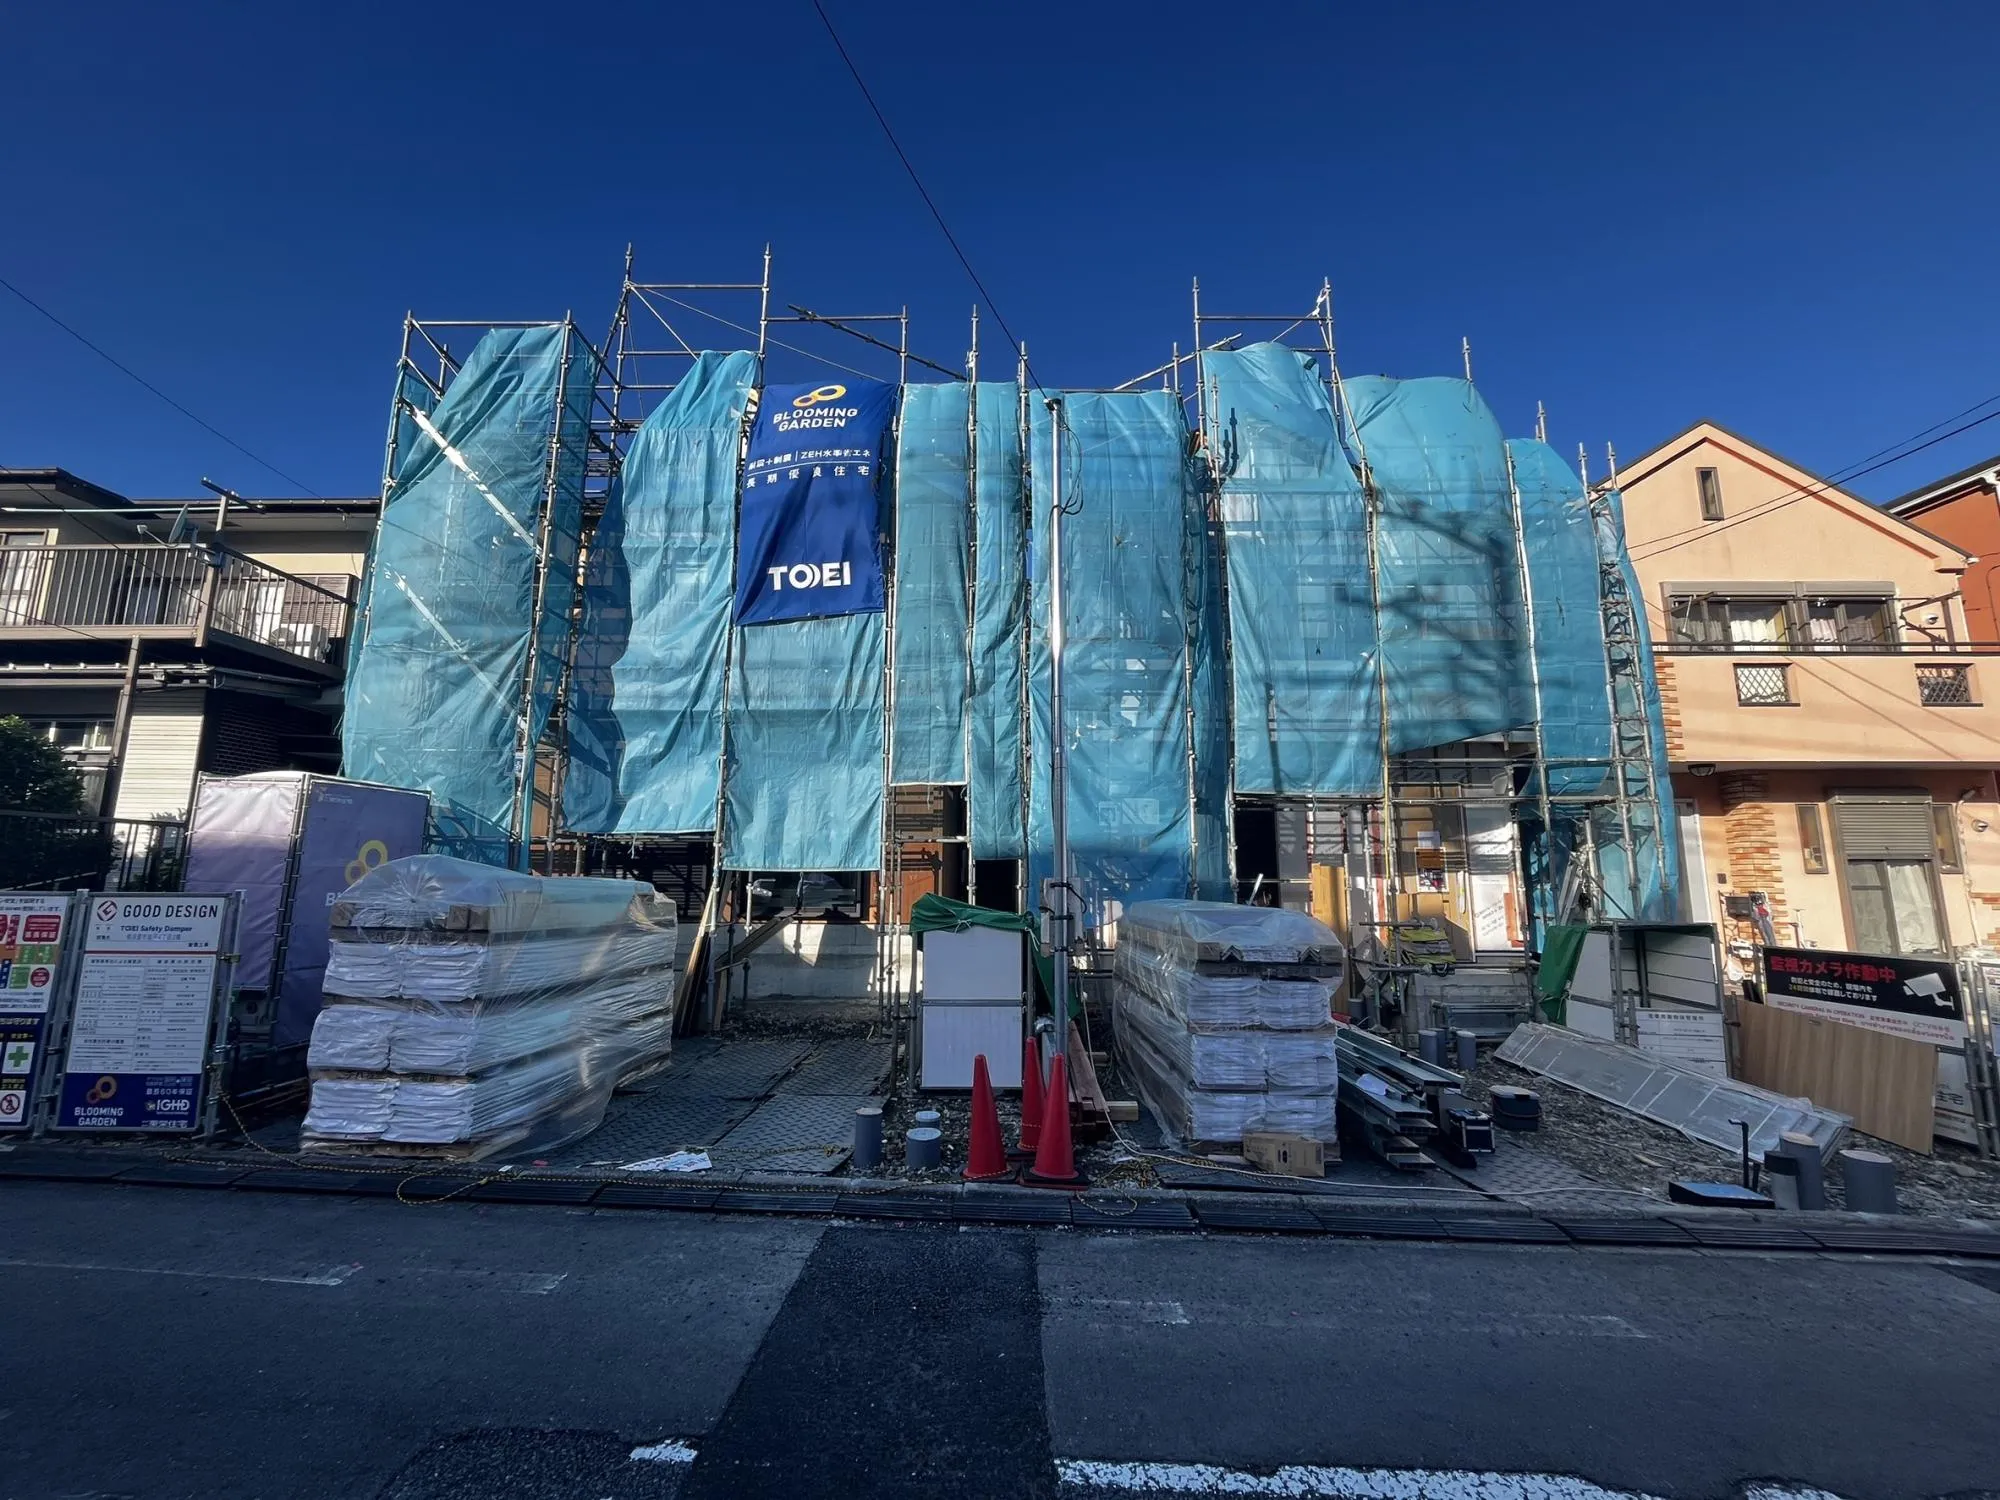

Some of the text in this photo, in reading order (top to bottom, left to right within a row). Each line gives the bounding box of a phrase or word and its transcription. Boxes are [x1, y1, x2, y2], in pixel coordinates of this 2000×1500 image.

[773, 408, 858, 424] BLOOMING
[778, 418, 846, 432] GARDEN
[746, 465, 869, 488] 長期優良住宅
[123, 904, 218, 918] GOOD DESIGN
[140, 925, 163, 933] Safety
[164, 925, 193, 933] Damper
[1770, 955, 1897, 984] 監視カメラ作動中
[74, 1107, 124, 1117] BLOOMING
[78, 1117, 117, 1126] GARDEN
